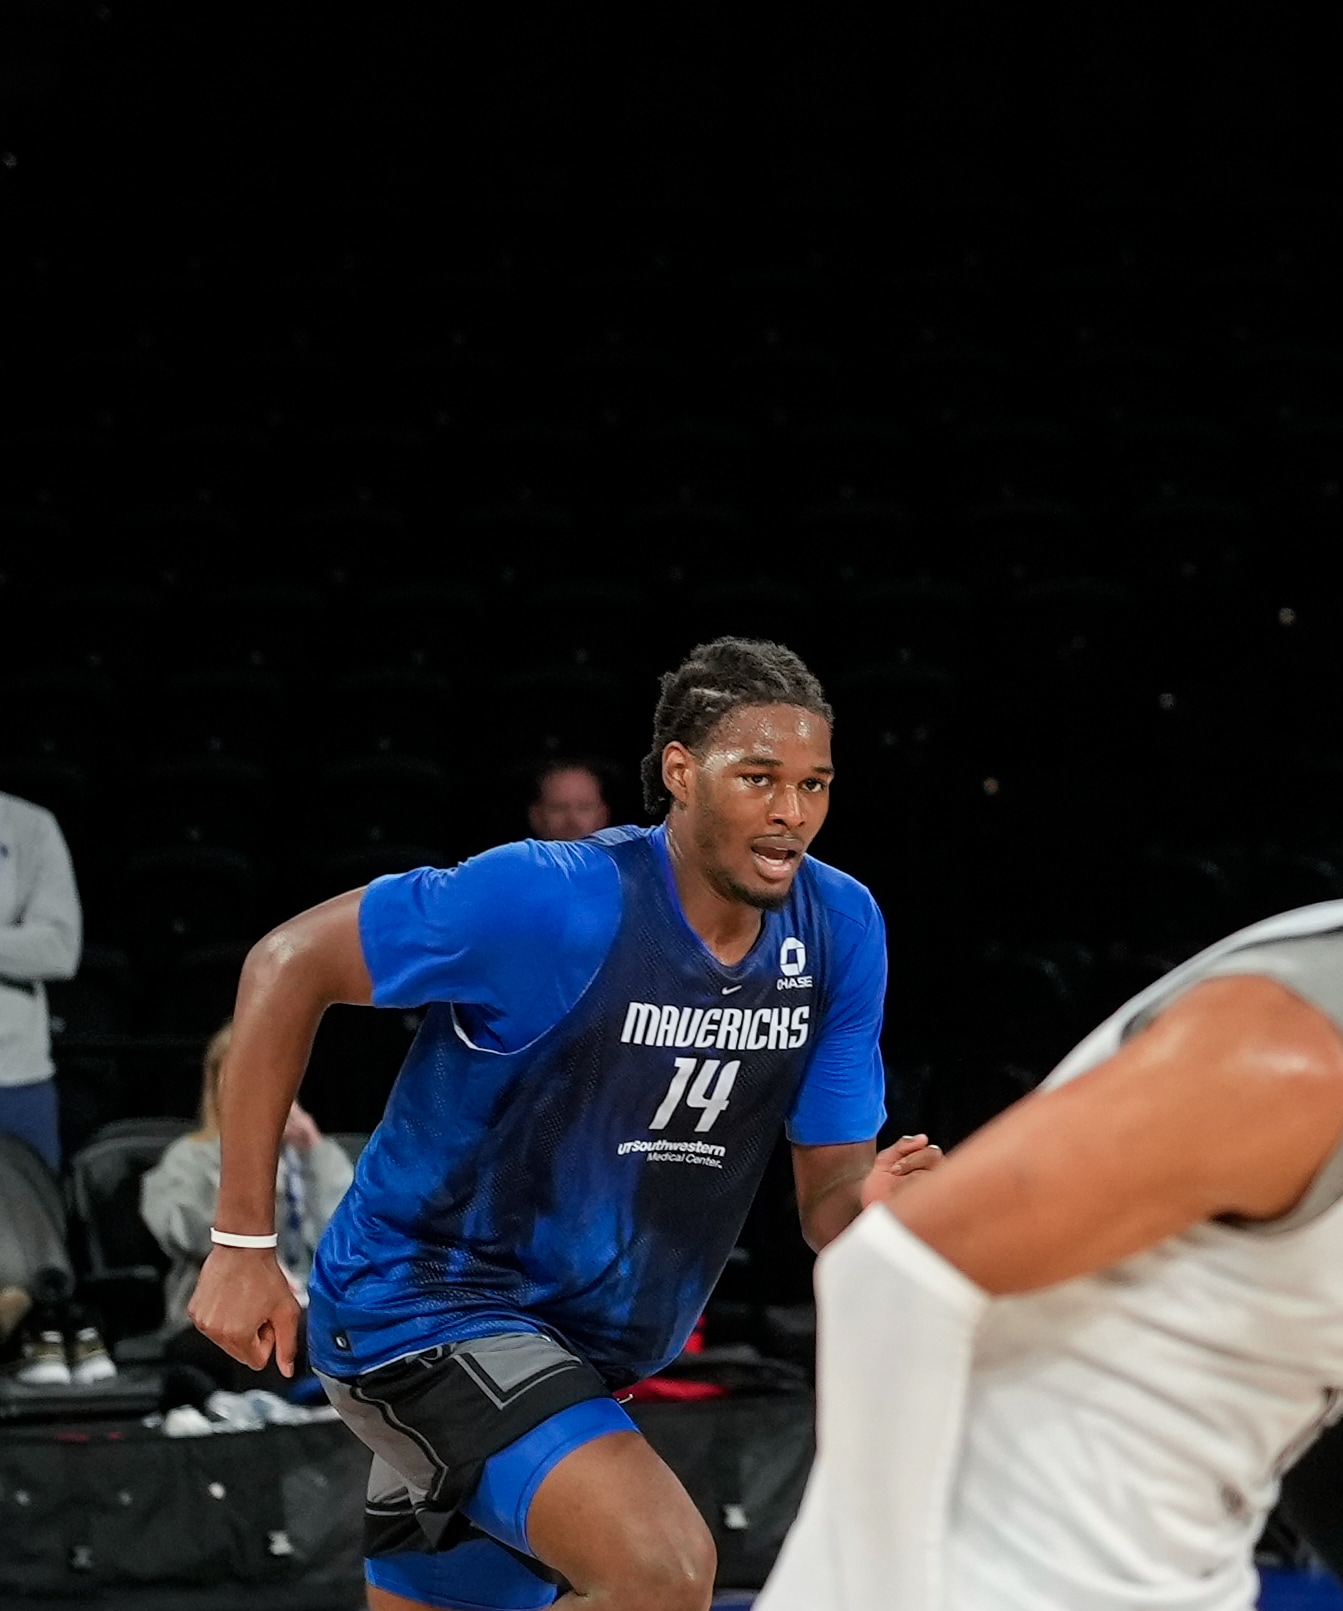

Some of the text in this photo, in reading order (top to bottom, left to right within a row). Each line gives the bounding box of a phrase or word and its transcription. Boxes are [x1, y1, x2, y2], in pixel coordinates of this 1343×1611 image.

[777, 975, 813, 990] CHASE
[620, 1001, 810, 1050] MAVERICKS
[649, 1057, 741, 1132] 14
[646, 1152, 685, 1162] Medical
